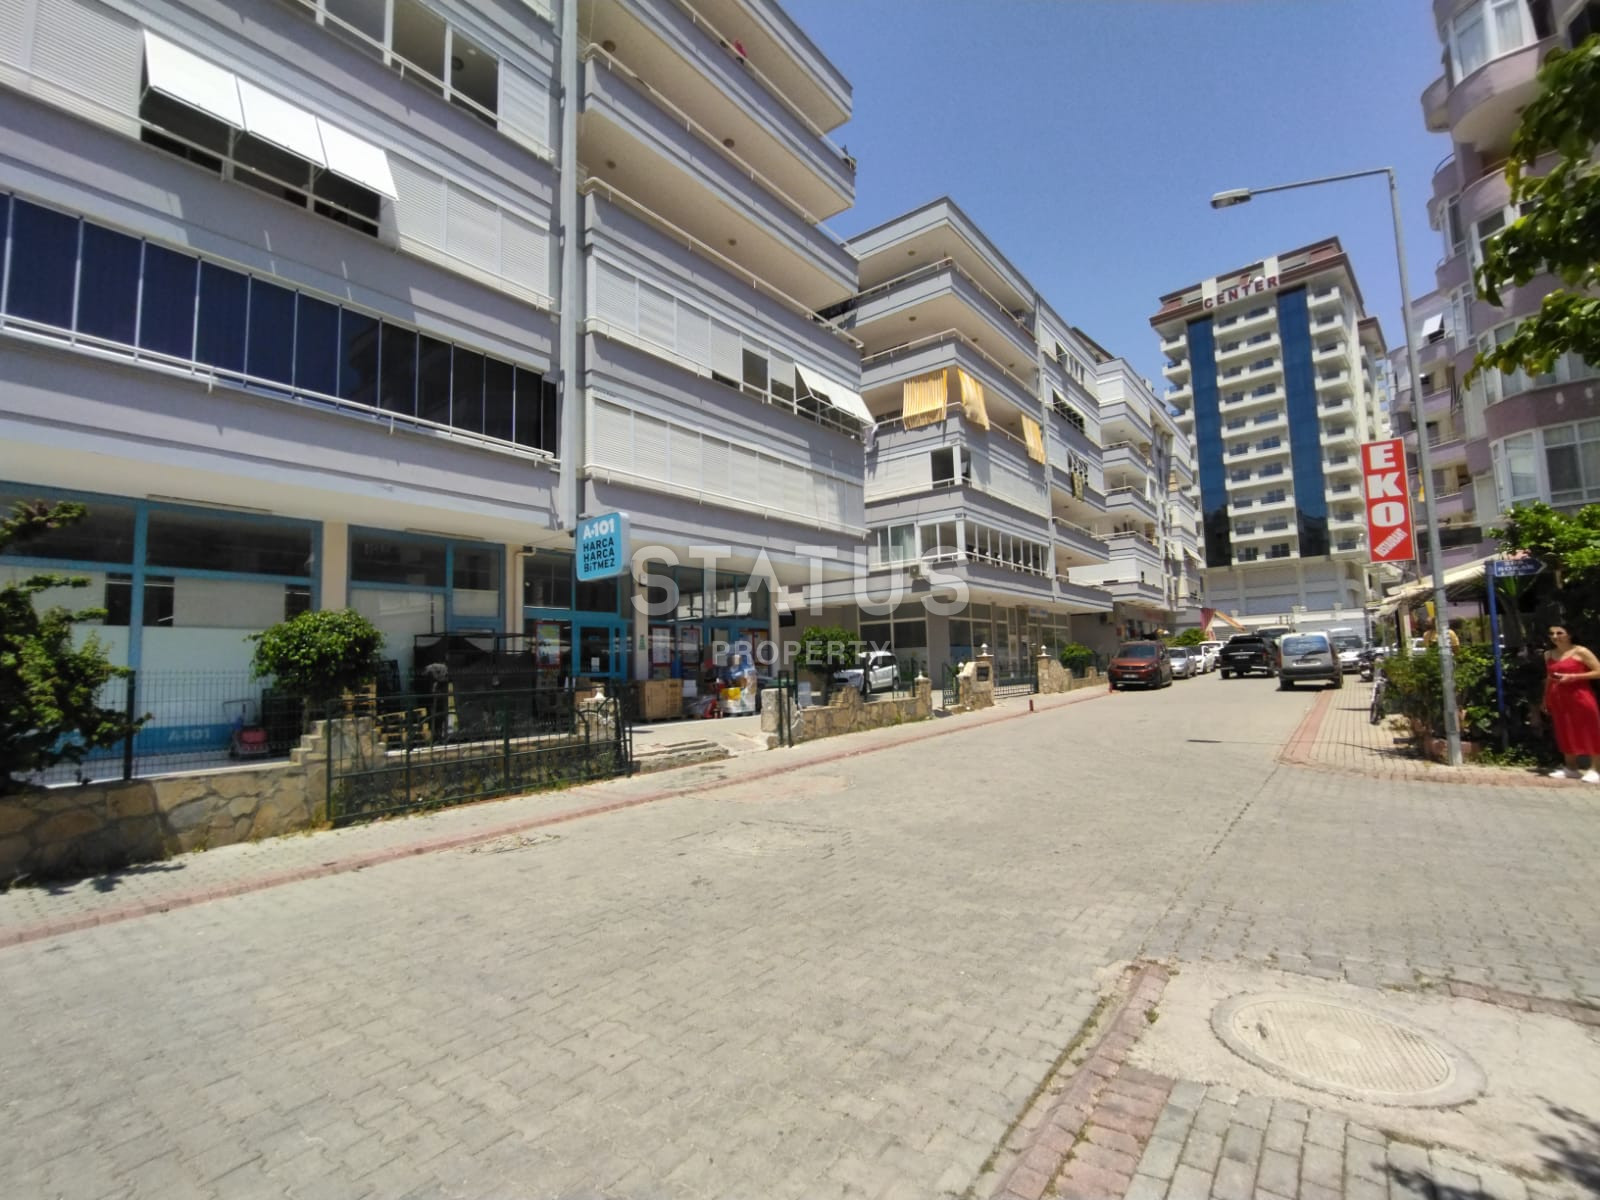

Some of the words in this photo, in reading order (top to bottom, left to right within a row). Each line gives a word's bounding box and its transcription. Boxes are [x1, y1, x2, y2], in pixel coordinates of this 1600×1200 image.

[1204, 275, 1279, 309] CENTER
[1367, 443, 1405, 527] EKO
[583, 537, 614, 552] HARCA
[583, 547, 615, 563] HARCA
